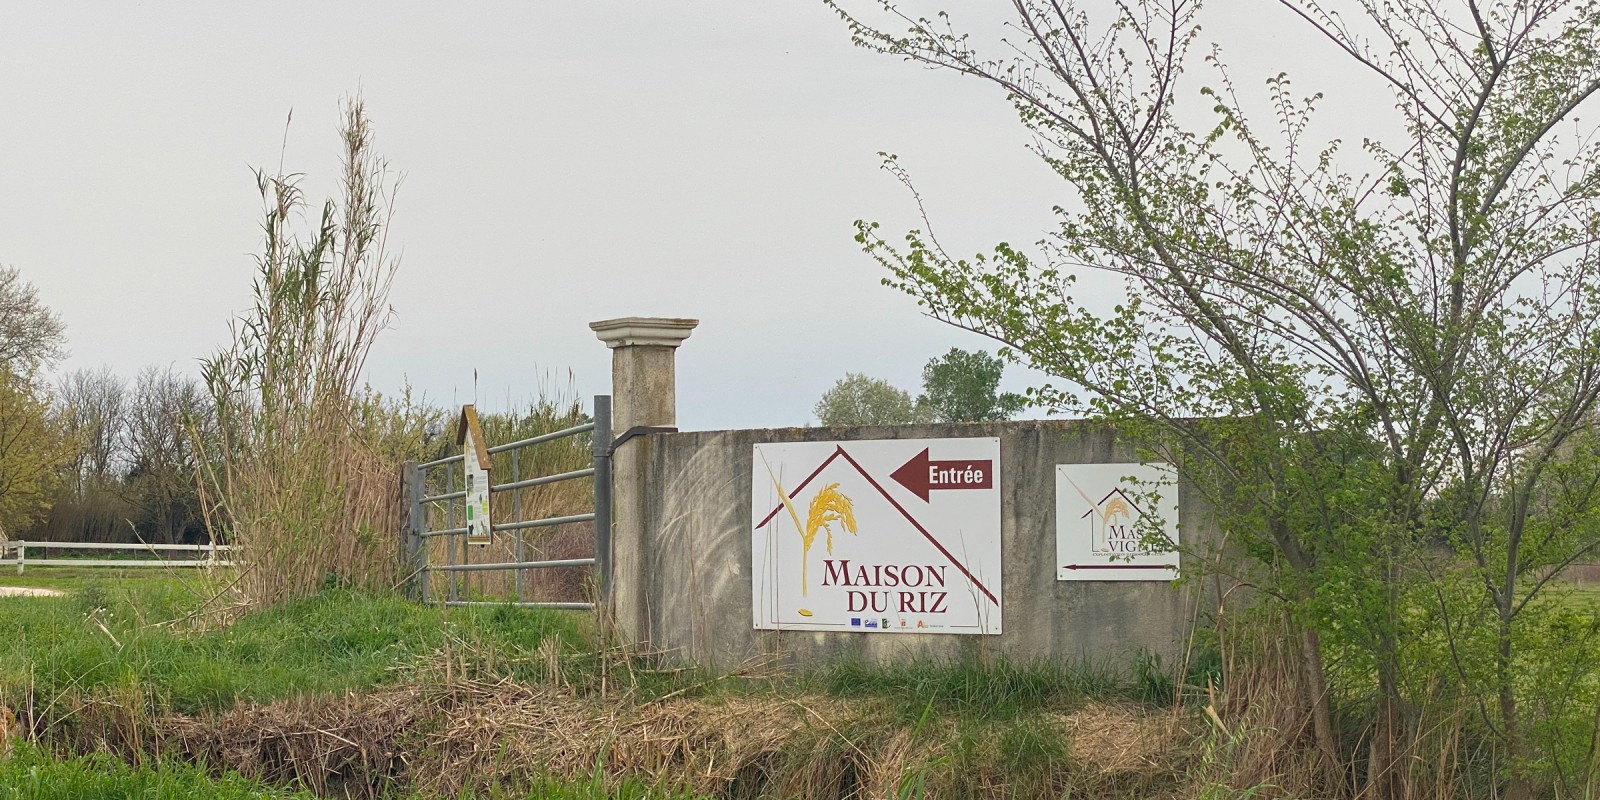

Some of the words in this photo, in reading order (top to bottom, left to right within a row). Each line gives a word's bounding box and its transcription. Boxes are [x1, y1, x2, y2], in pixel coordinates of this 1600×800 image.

[928, 464, 983, 484] Entrée
[822, 559, 947, 588] MAISON
[846, 590, 889, 613] DU
[898, 591, 948, 614] RIZ
